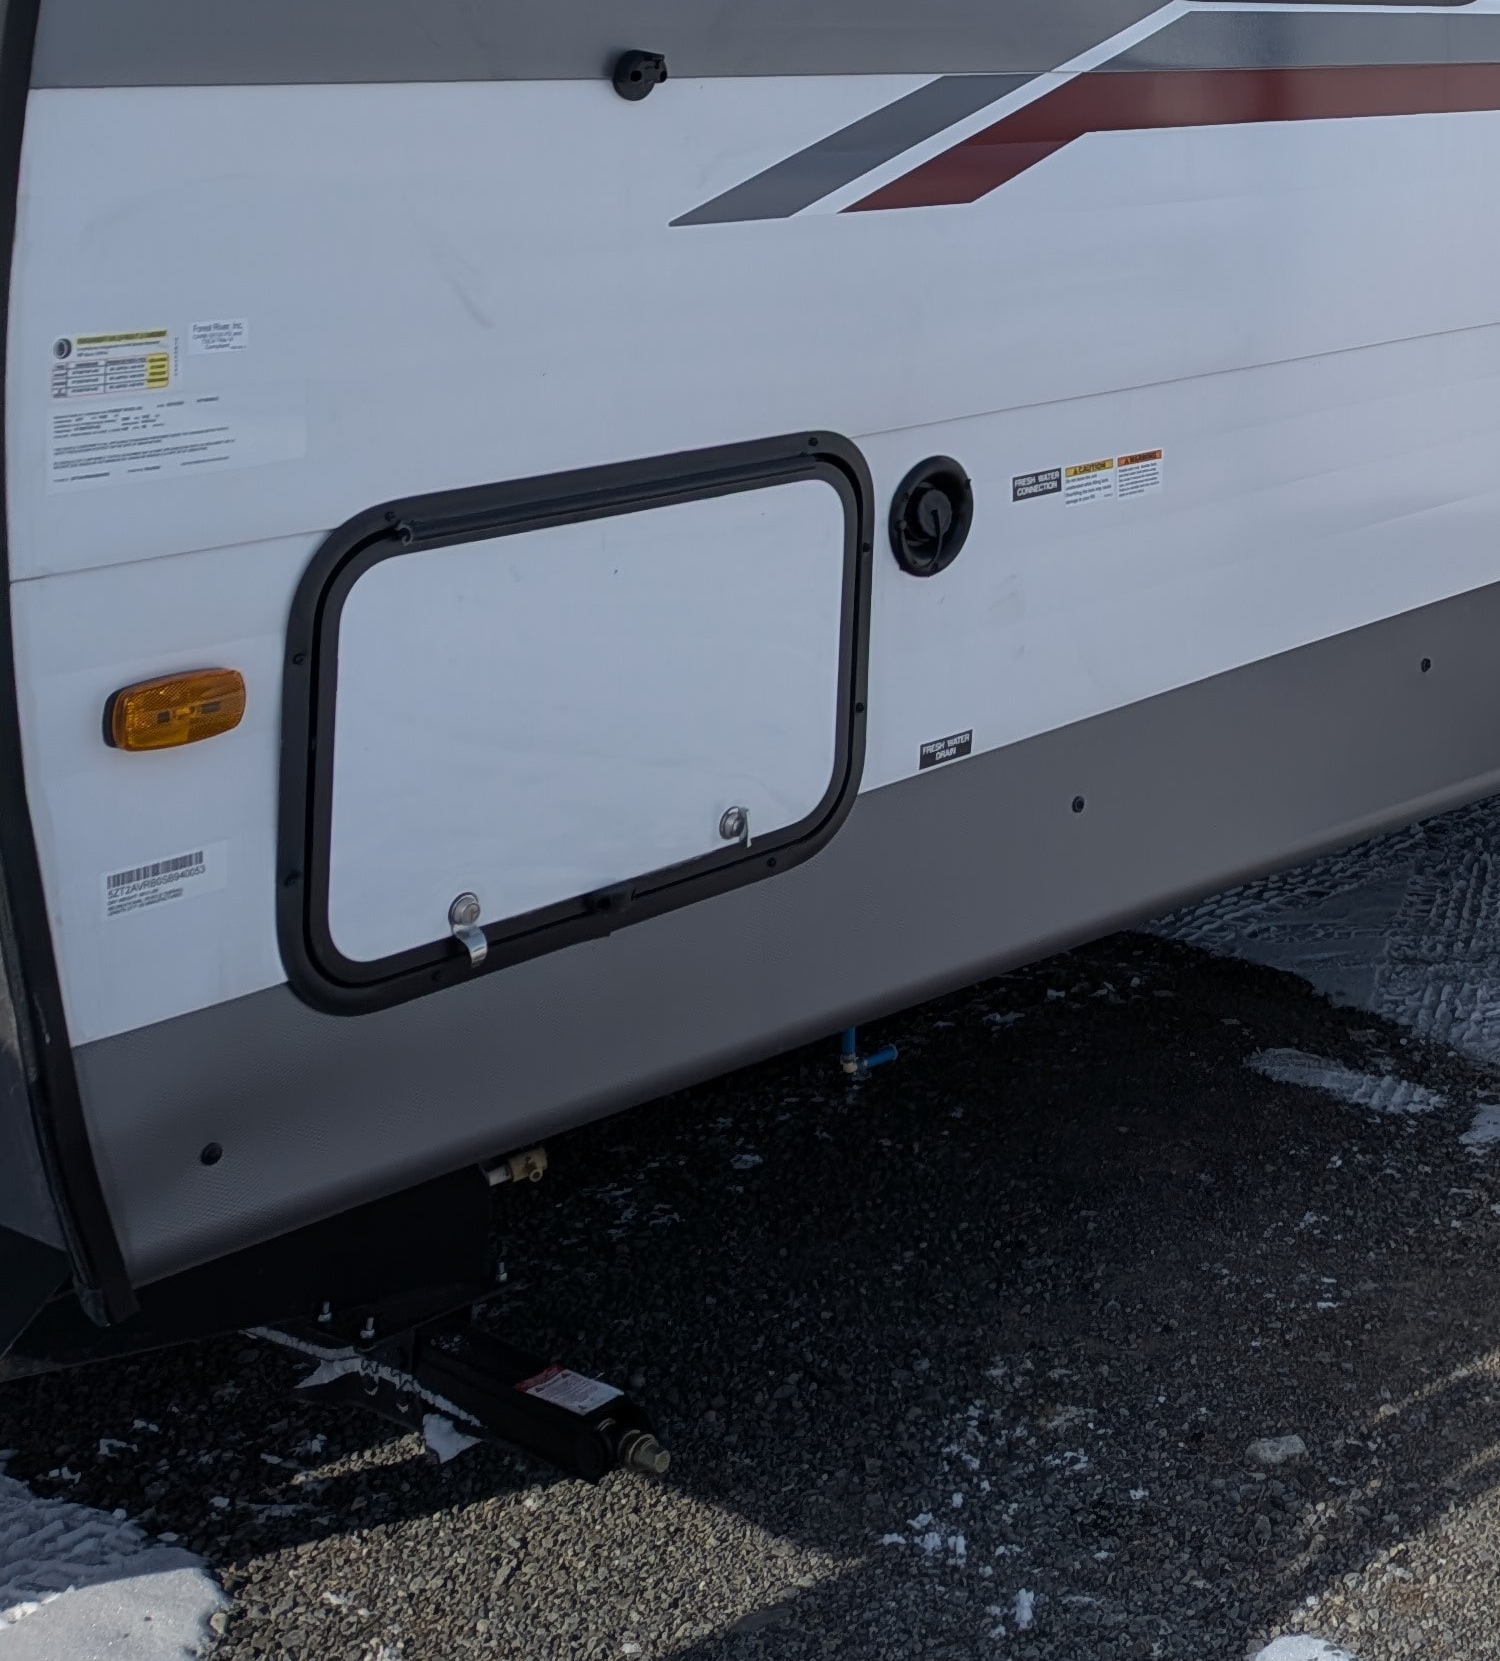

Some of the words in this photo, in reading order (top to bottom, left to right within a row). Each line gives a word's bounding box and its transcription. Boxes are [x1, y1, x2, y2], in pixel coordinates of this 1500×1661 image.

[1079, 461, 1106, 474] CAUTION
[1014, 475, 1036, 488] FRESH
[1037, 470, 1060, 482] WATER
[1016, 480, 1058, 497] CONNECTION
[922, 741, 945, 755] FRESH
[947, 733, 970, 747] WATER
[935, 746, 957, 760] DRAIN
